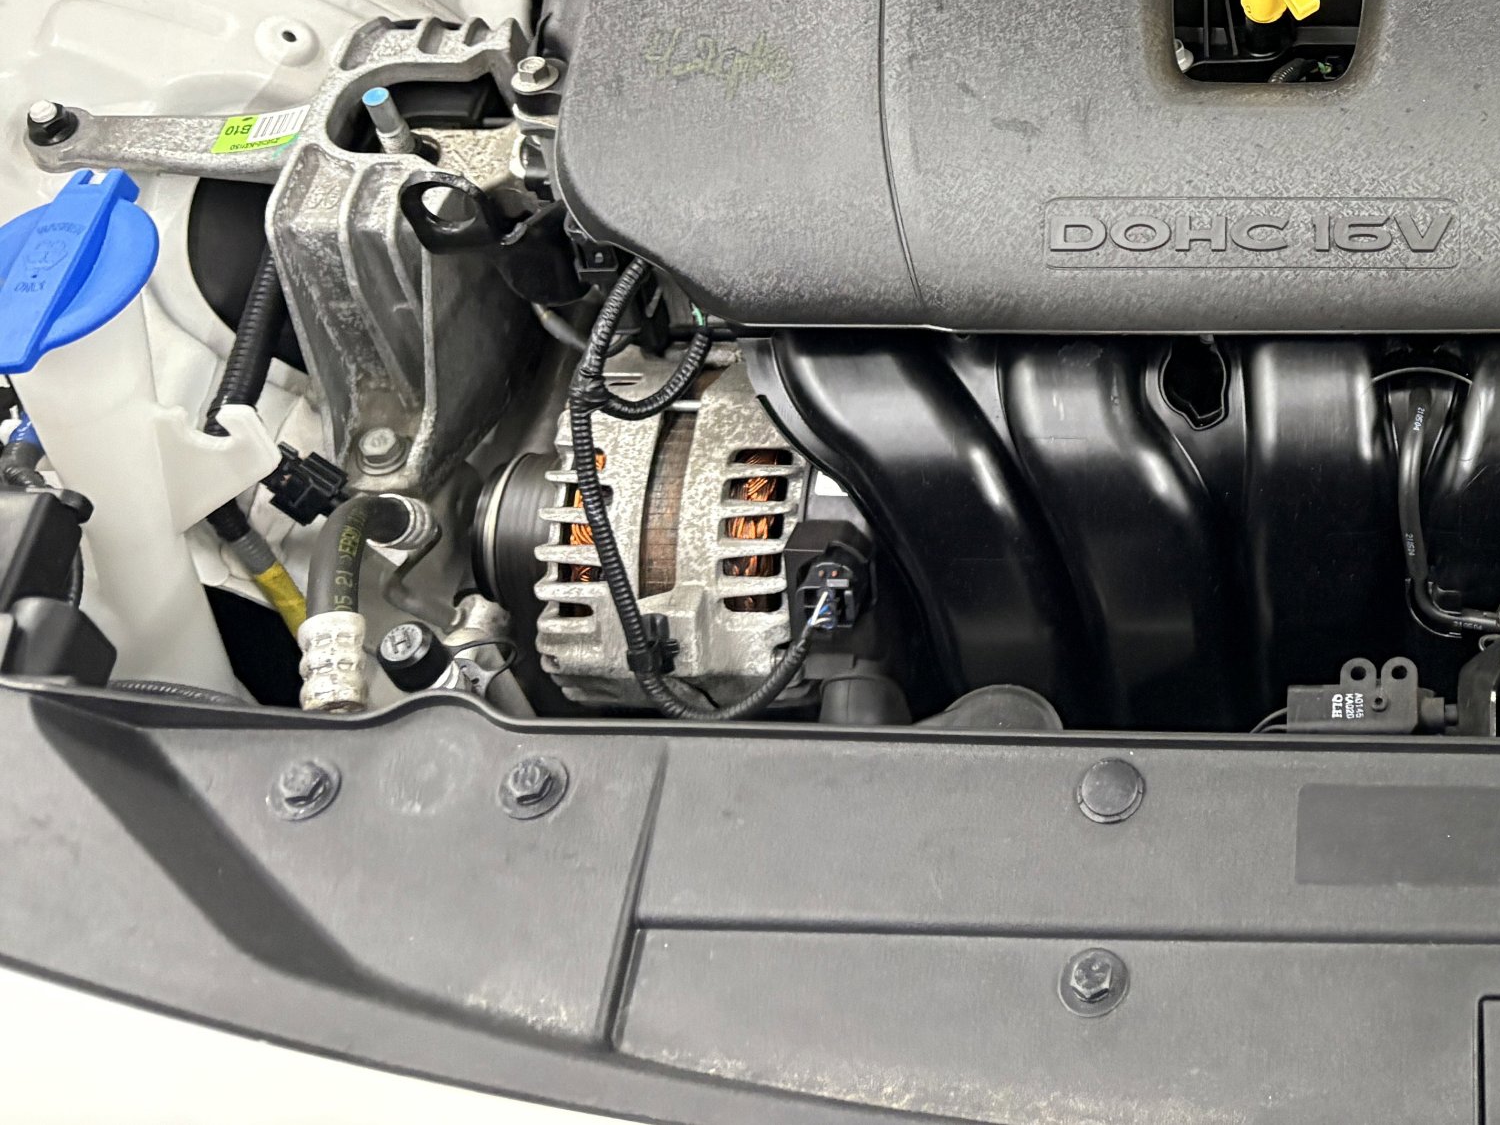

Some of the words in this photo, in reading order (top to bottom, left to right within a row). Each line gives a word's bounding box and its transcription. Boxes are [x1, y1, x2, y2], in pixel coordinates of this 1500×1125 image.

[225, 124, 253, 136] B10
[1049, 215, 1290, 253] DOHC
[1311, 215, 1454, 253] 16V
